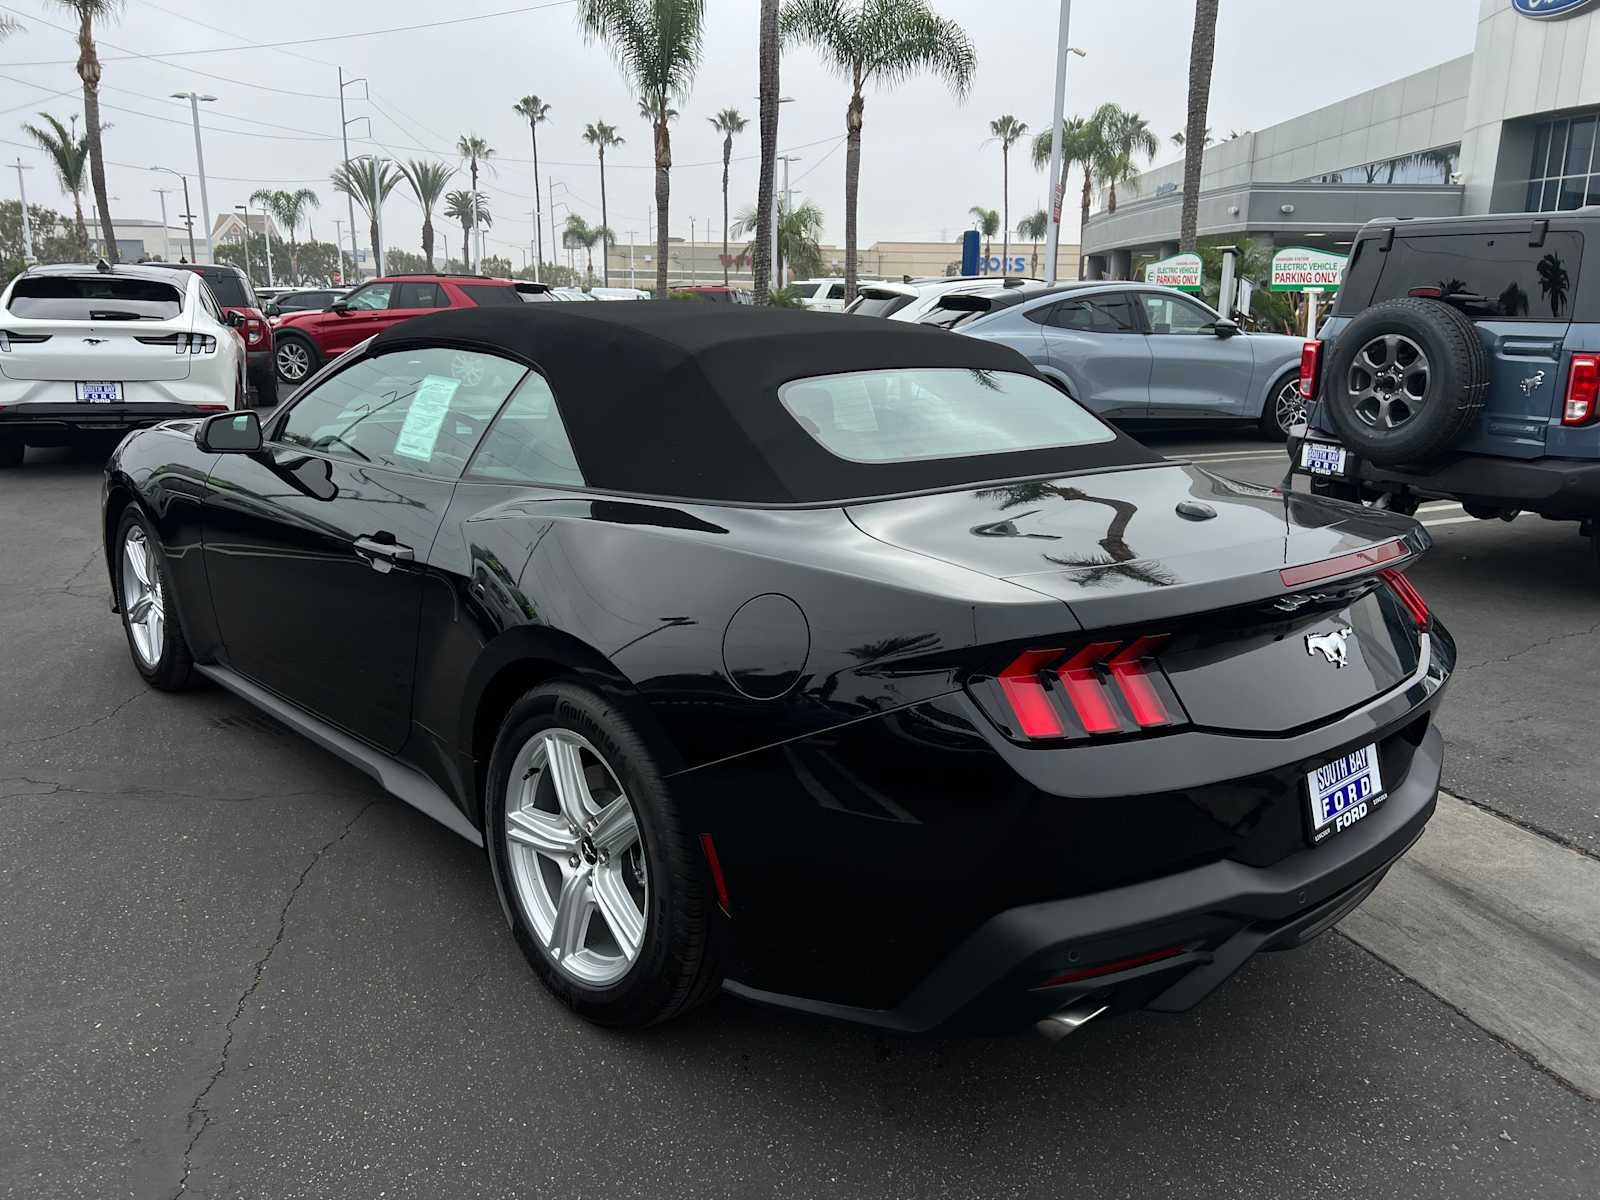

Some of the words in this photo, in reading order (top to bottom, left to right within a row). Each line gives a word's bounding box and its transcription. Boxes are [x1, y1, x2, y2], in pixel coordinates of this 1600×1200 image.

[1275, 263, 1308, 271] ELECTRIC
[1309, 262, 1338, 271] VEHICLE
[1156, 274, 1181, 285] PARKING
[1182, 274, 1199, 285] ONLY
[1275, 272, 1312, 283] PARKING
[1314, 271, 1338, 283] ONLY
[1308, 448, 1327, 460] SOUTH
[1328, 451, 1339, 462] BAY
[1307, 459, 1338, 471] FORD
[1317, 757, 1348, 790] SOUTH
[1348, 747, 1367, 773] BAY
[1322, 776, 1371, 819] FORD
[1335, 802, 1368, 832] FORD
